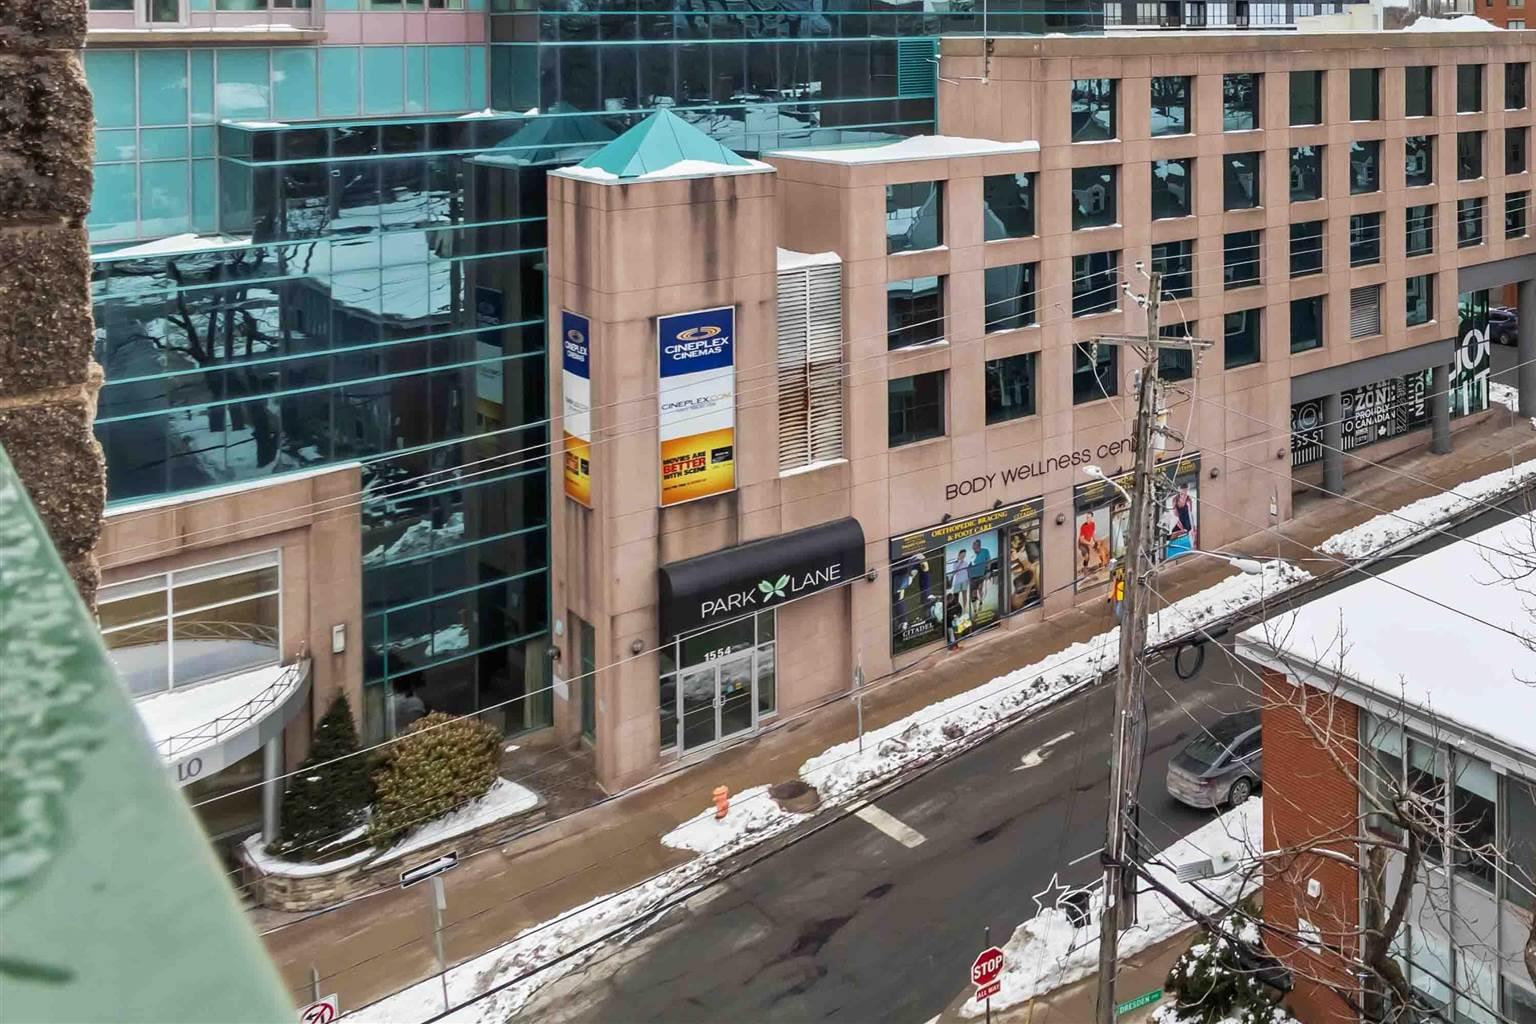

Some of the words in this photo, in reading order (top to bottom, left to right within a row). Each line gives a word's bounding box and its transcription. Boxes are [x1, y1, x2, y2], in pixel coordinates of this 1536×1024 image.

[664, 336, 730, 355] CINEPLEX
[672, 346, 723, 361] CINEMAS
[1355, 384, 1397, 413] ZONE
[1355, 410, 1396, 430] CANADIAN
[663, 457, 706, 475] BETTER
[946, 476, 996, 500] BODY
[931, 520, 976, 538] ORTHOPEDIC
[977, 511, 1008, 525] BRACING
[953, 530, 973, 539] FOOT
[701, 588, 757, 619] PARK
[791, 563, 841, 593] LANE
[902, 622, 934, 638] CITADEL
[704, 646, 731, 662] 1554
[974, 955, 1003, 979] STOP
[977, 991, 987, 1000] ALL
[988, 984, 1001, 994] WAY
[1119, 997, 1150, 1015] DRESDEN
